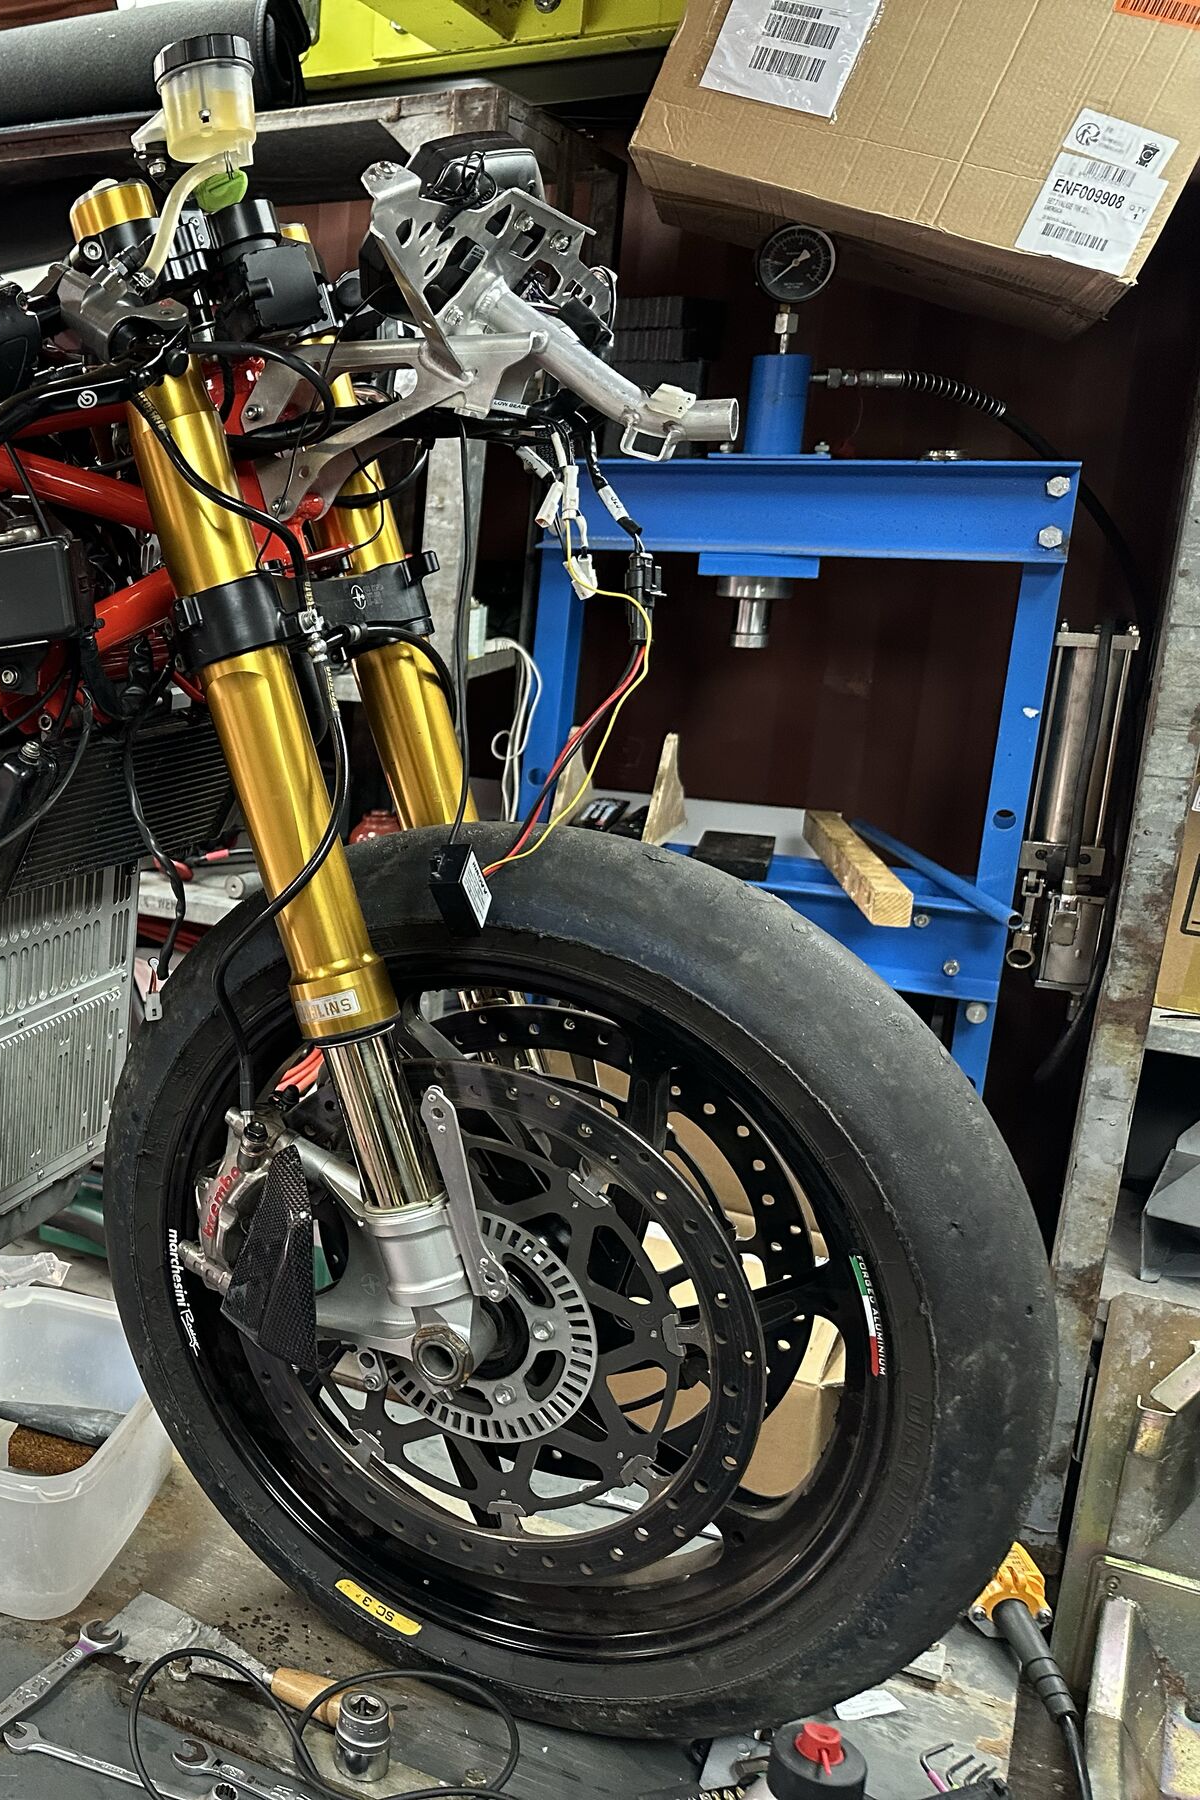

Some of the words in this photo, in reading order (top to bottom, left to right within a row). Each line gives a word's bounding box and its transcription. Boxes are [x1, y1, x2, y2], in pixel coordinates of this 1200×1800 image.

[1052, 178, 1126, 209] ENF009908
[202, 1166, 241, 1239] brembo
[168, 1228, 189, 1310] marchesini
[855, 1255, 877, 1304] FORGED
[871, 1307, 887, 1376] ALUMINIUM
[362, 1596, 373, 1607] 3
[375, 1604, 395, 1622] SC
